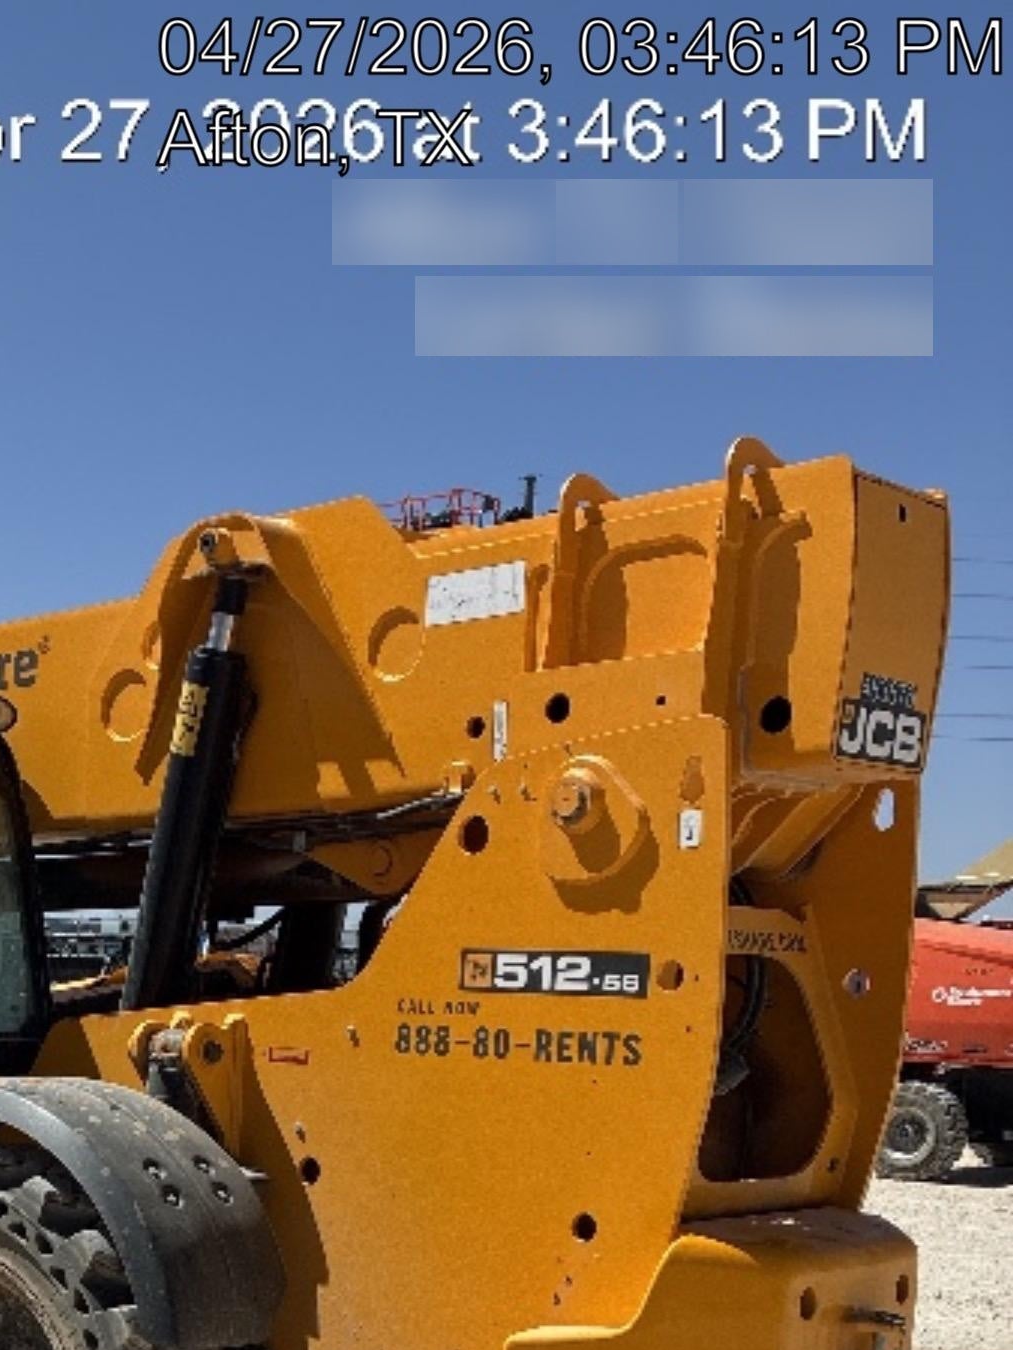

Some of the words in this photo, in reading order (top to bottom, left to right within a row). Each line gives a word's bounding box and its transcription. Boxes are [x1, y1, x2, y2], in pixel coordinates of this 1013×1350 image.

[840, 706, 922, 763] JCB
[396, 998, 435, 1016] CALL
[394, 1022, 643, 1067] 888-80-RENTS
